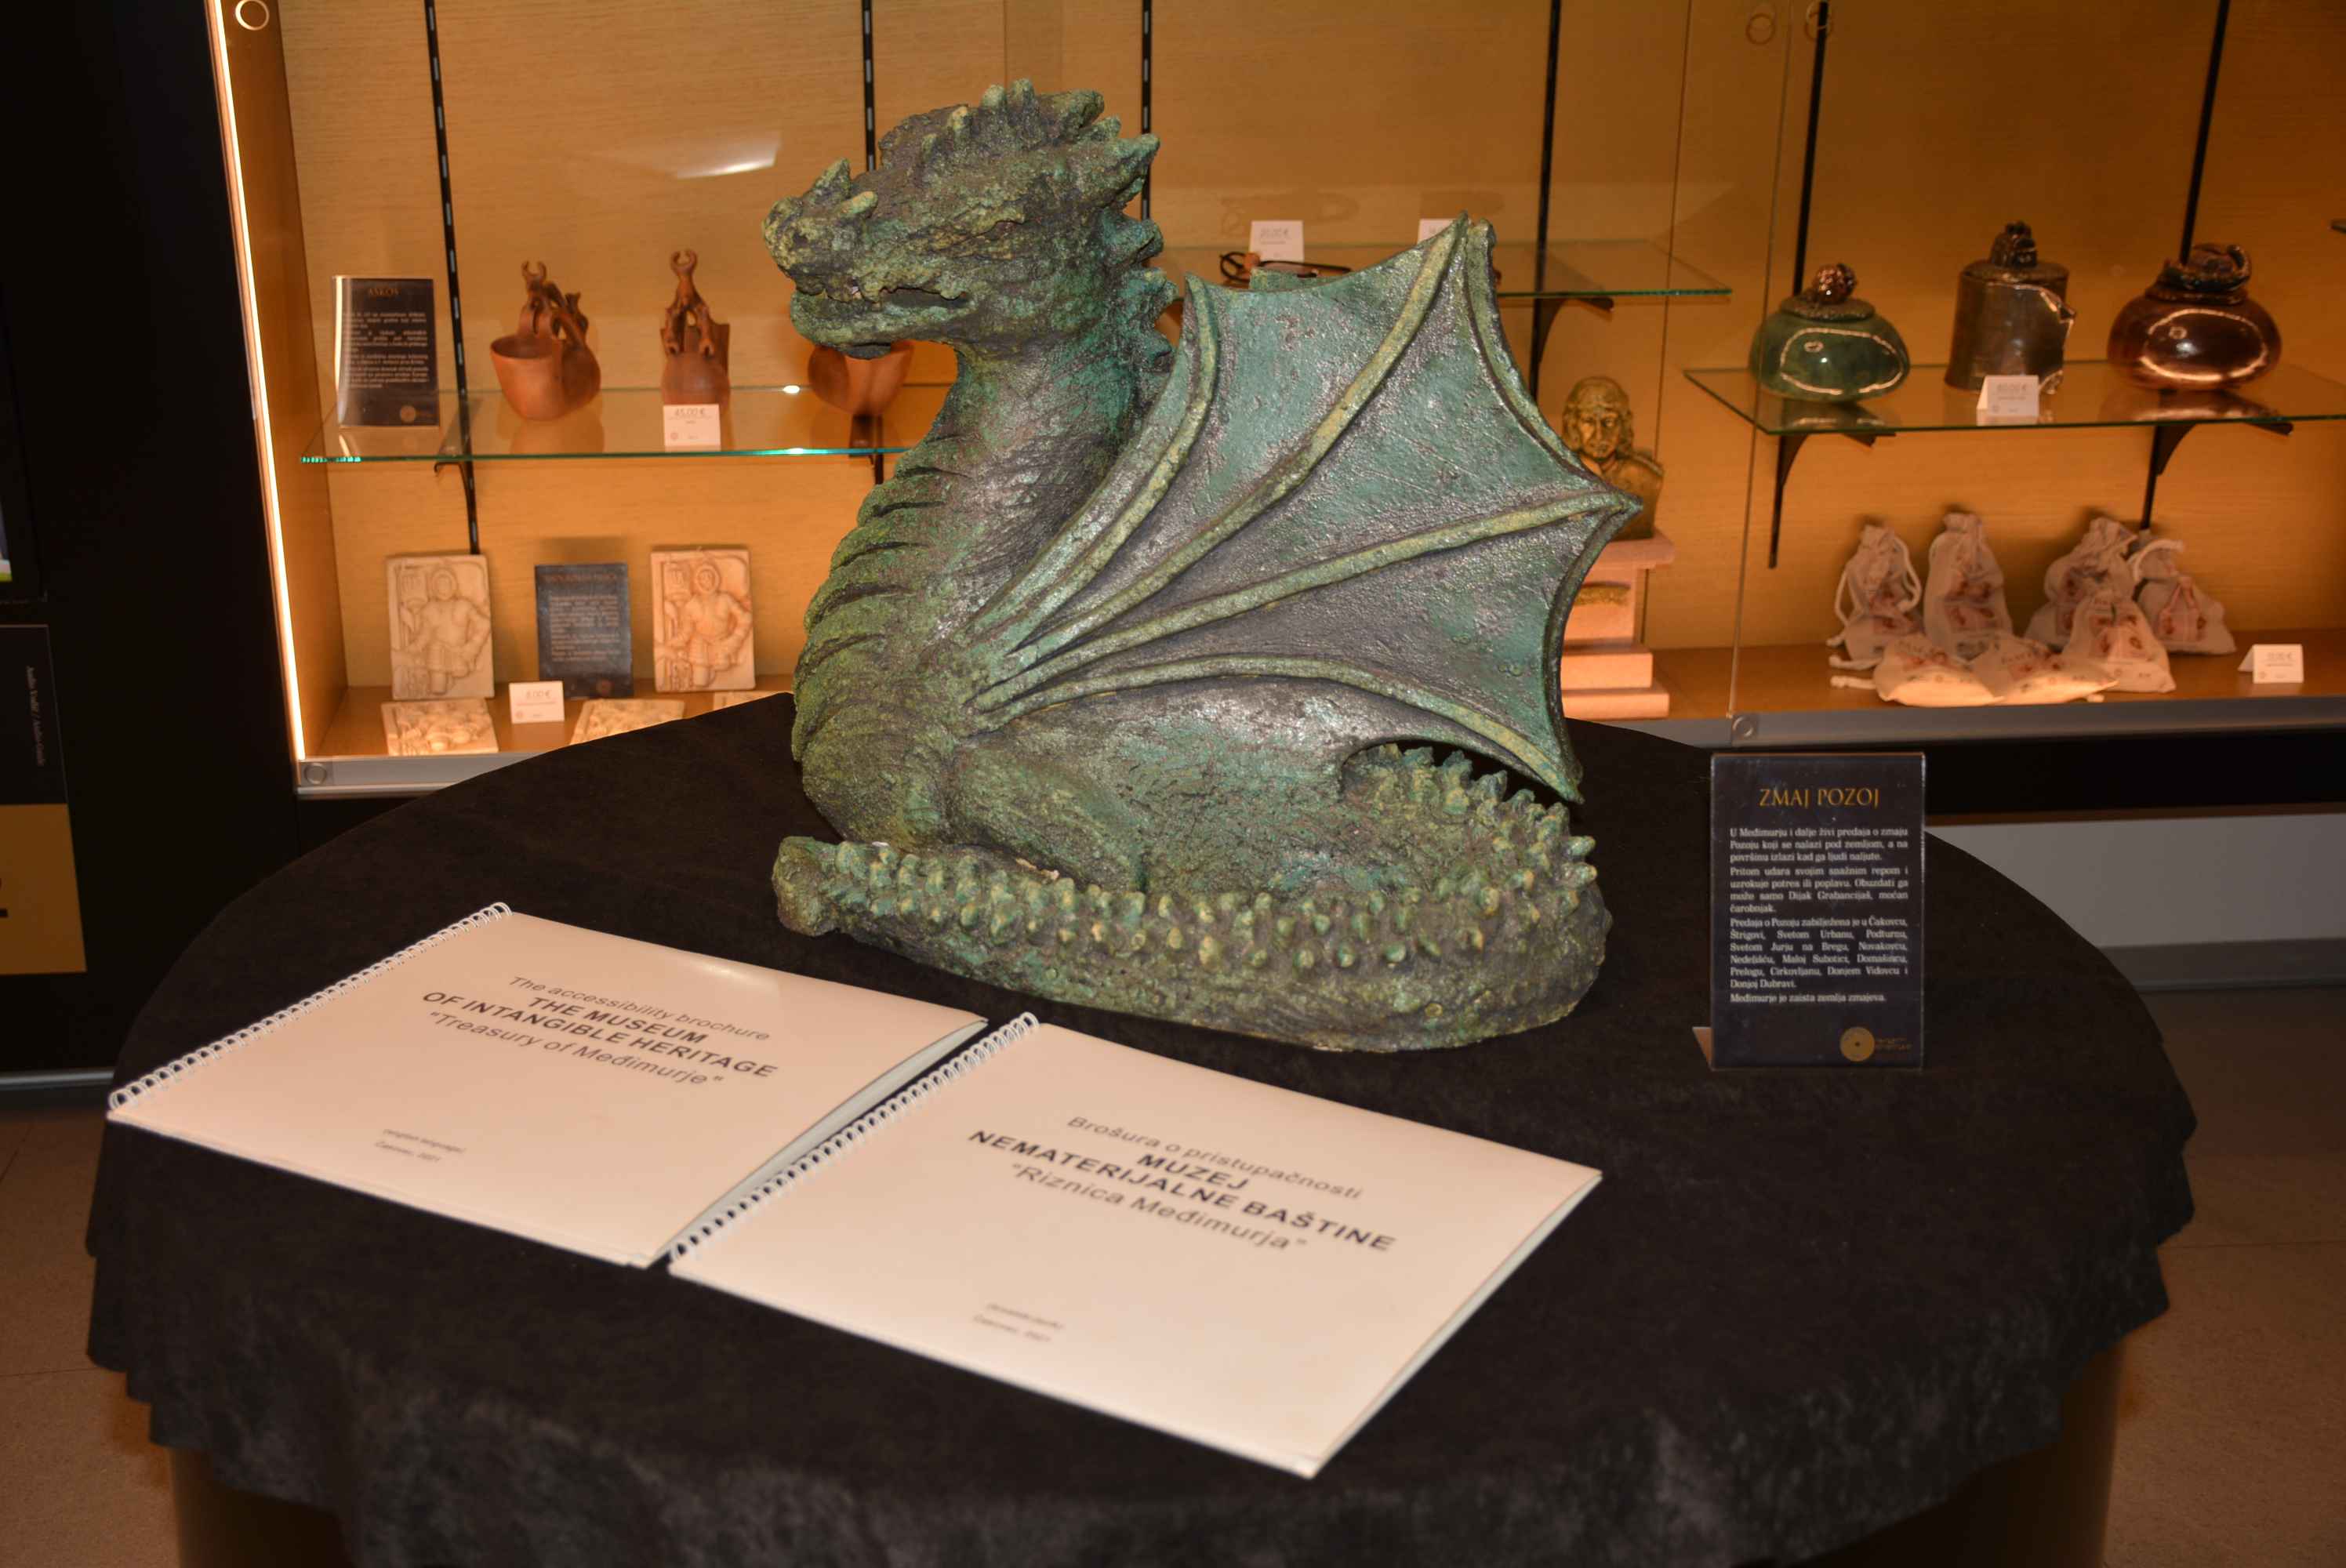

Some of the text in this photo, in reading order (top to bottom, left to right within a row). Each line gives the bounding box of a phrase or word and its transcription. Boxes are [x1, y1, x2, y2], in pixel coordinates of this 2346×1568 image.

[1759, 787, 1880, 809] ZMAJ POZOJ
[423, 992, 779, 1078] OF INTANGIBLE HERITAGE
[509, 977, 770, 1040] The accessibility brochure
[528, 996, 709, 1044] THE MUSEUM
[543, 1040, 577, 1053] of
[1067, 1116, 1364, 1200] Brošura o pristupačnosti
[1136, 1153, 1250, 1190] MUZEJ
[968, 1130, 1396, 1252] NEMATERIJALNE BAŠTINE
